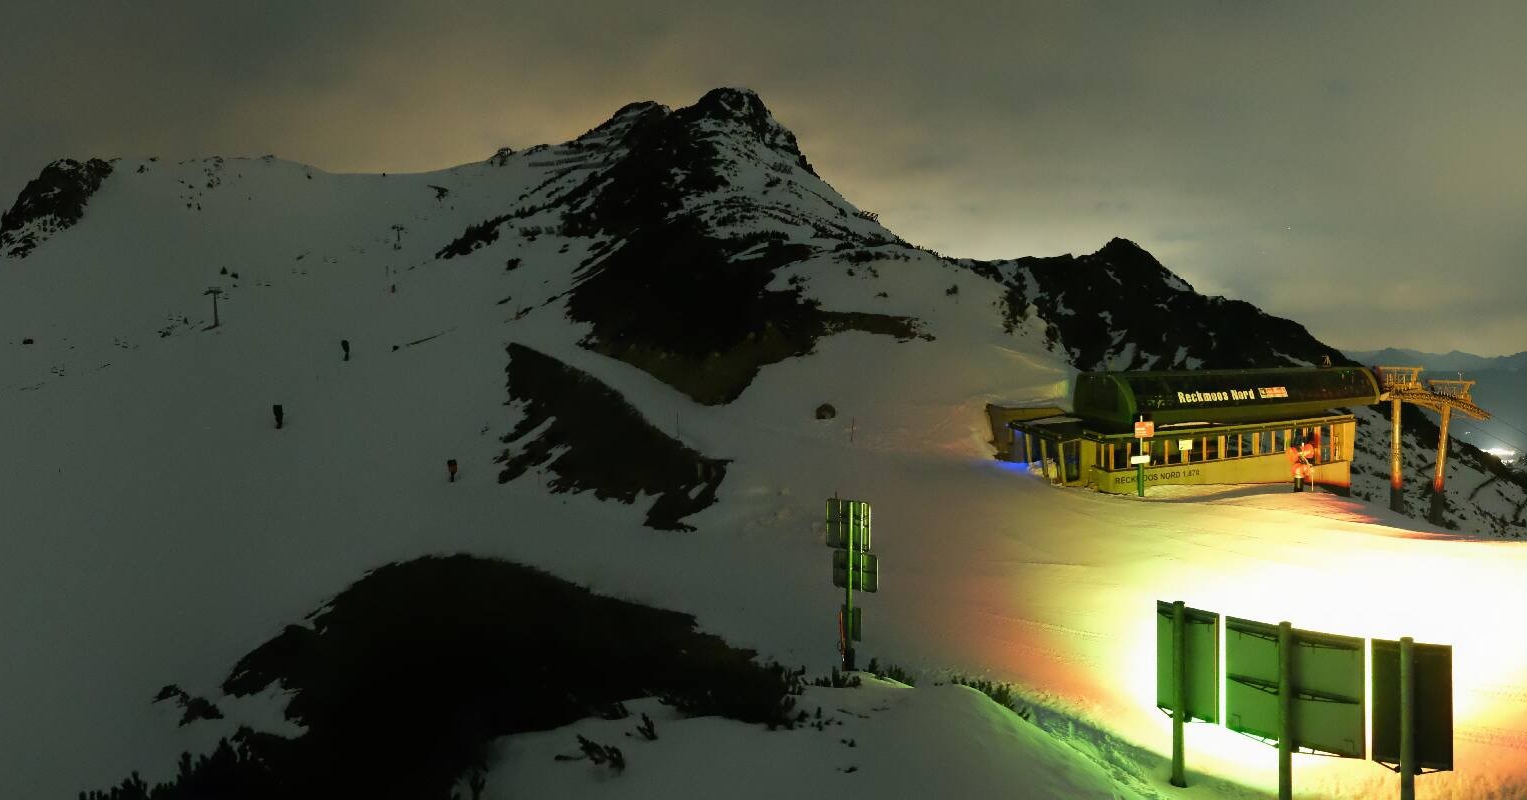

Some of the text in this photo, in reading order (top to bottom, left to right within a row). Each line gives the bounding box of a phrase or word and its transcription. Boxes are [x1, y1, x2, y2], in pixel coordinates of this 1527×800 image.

[1177, 390, 1229, 403] Reckmoos
[1230, 388, 1255, 401] Nord
[1115, 473, 1158, 484] RECKOOS
[1160, 471, 1181, 480] NORD
